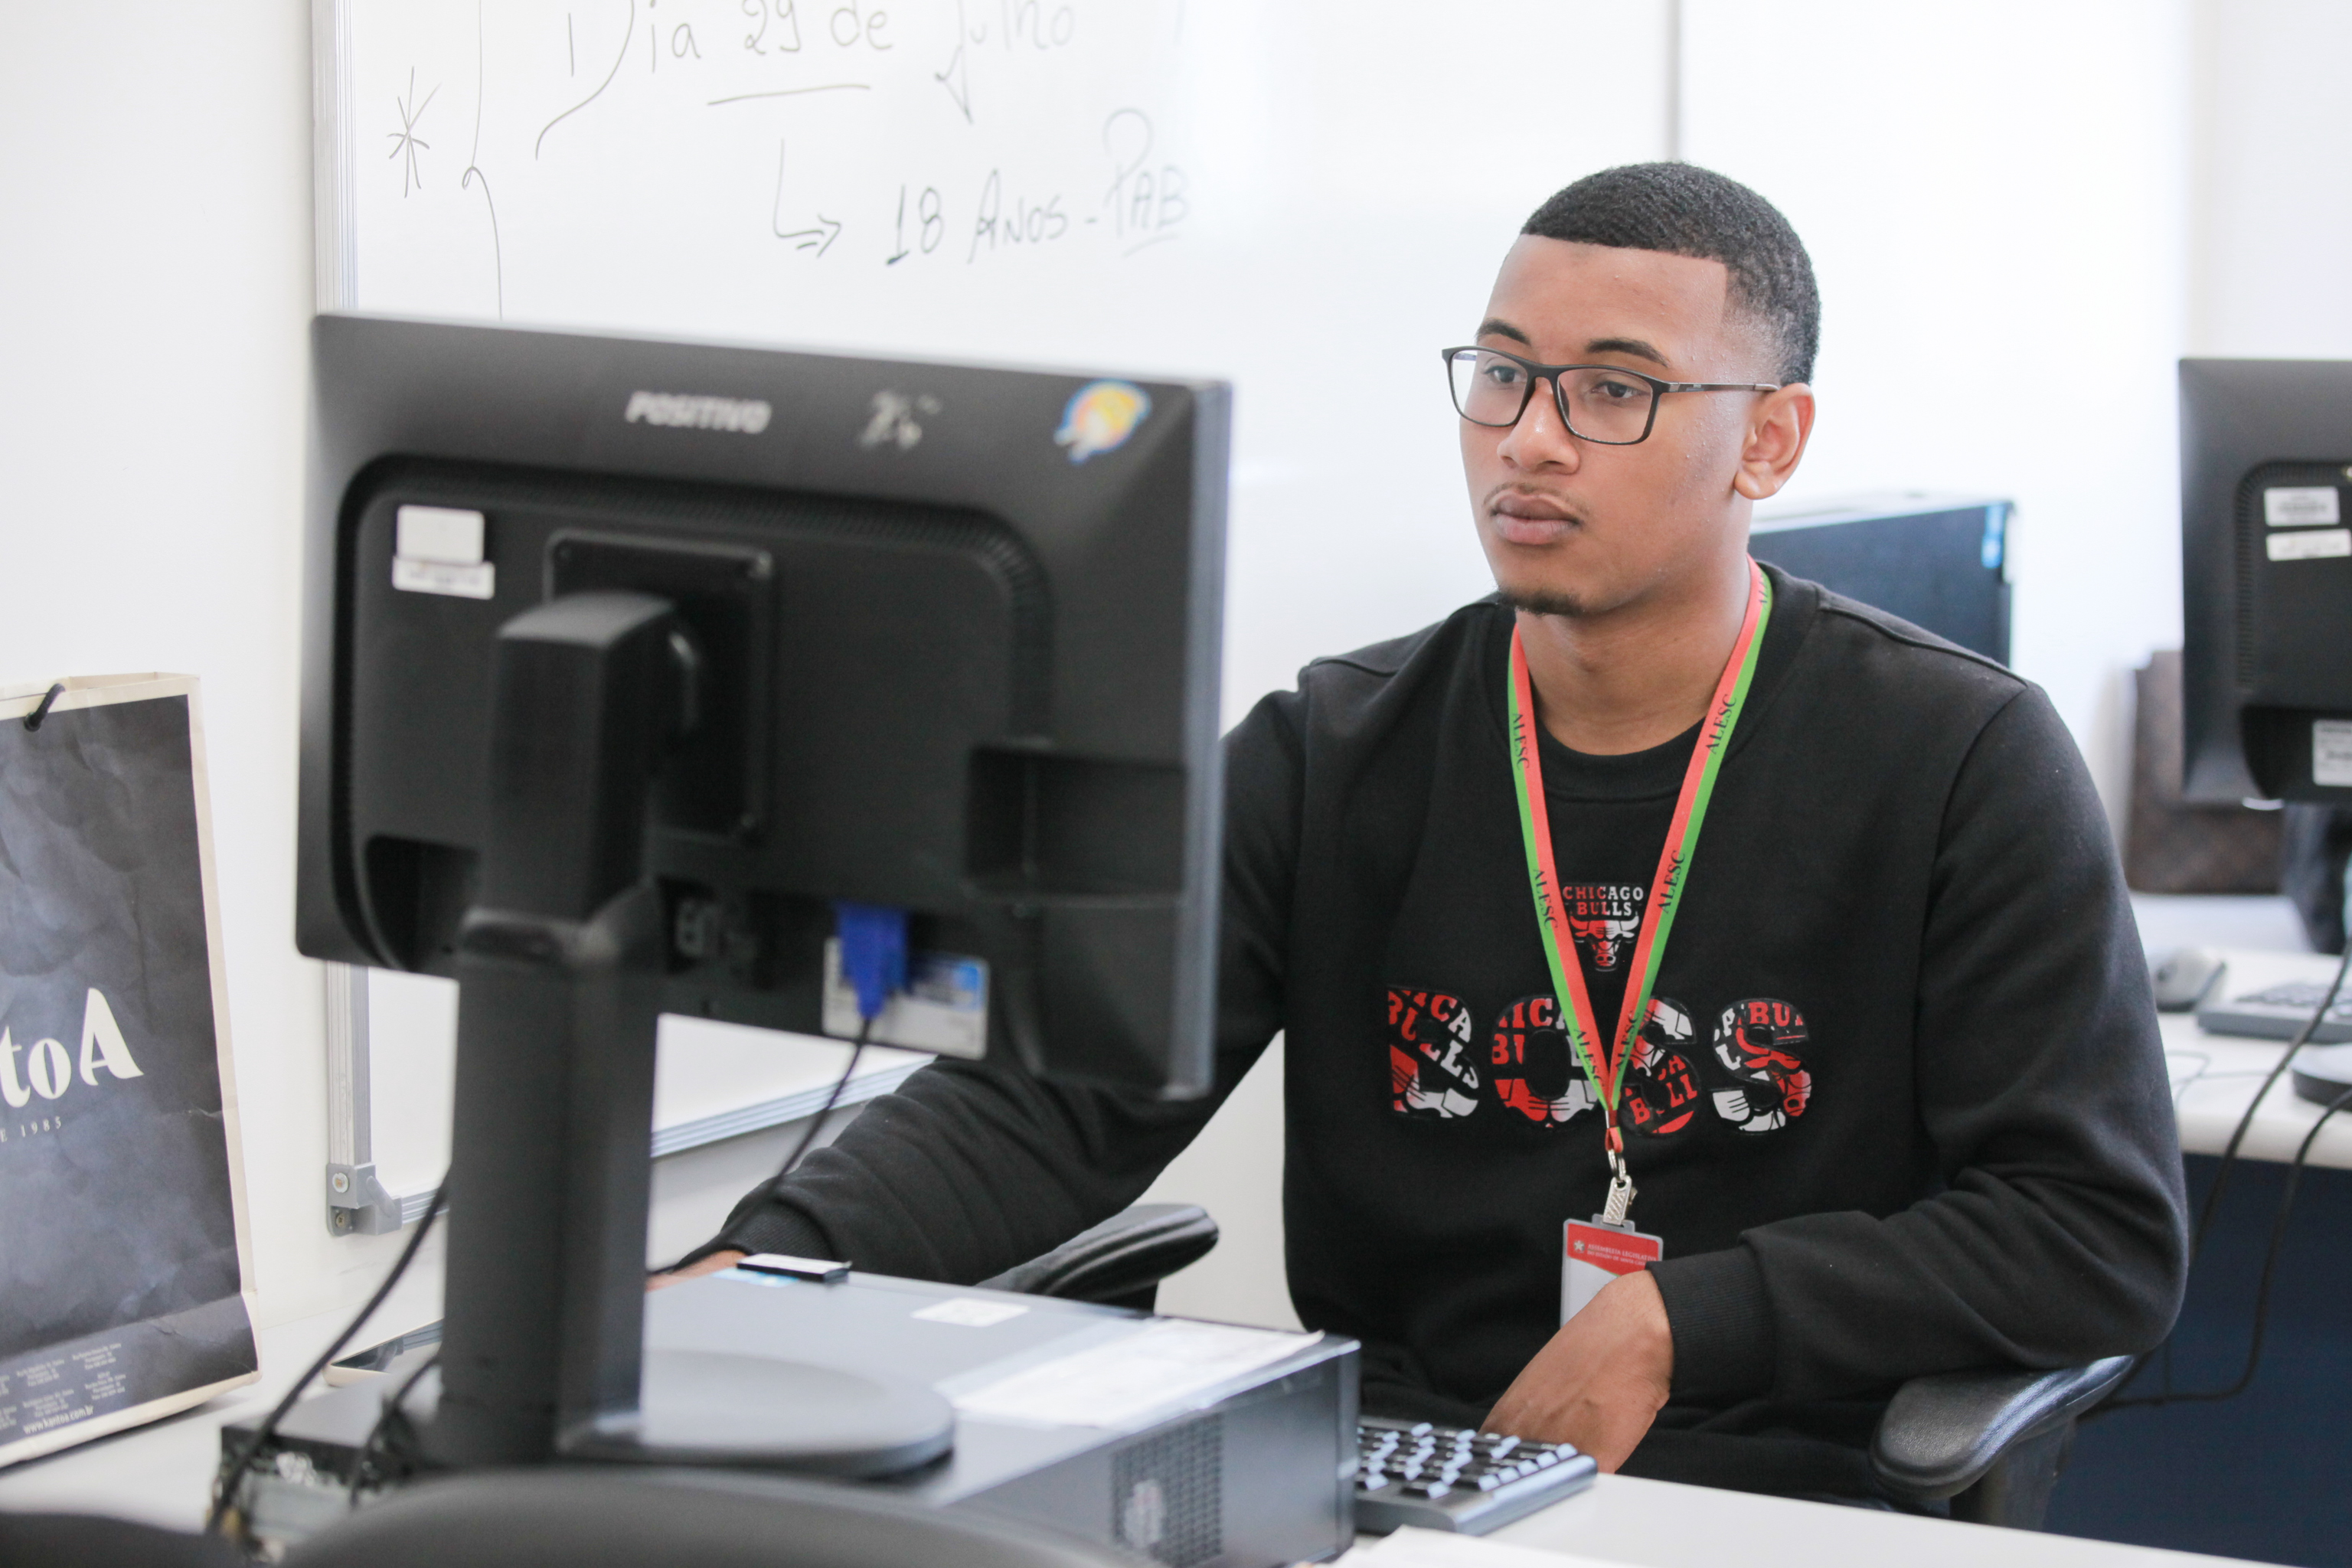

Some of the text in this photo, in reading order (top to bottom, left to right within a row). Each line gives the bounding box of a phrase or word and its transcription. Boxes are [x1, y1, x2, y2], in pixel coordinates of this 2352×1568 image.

[830, 0, 894, 51] de
[884, 182, 945, 266] 18
[1511, 713, 1530, 771] ALESC
[1704, 693, 1737, 756] ALESC
[1531, 867, 1559, 930] ALESC
[1563, 886, 1644, 901] CHICAGO
[1576, 902, 1632, 916] BULLS
[1656, 849, 1686, 915] ALESC
[1615, 1009, 1638, 1071] ALESC
[20, 1116, 62, 1138] 1985
